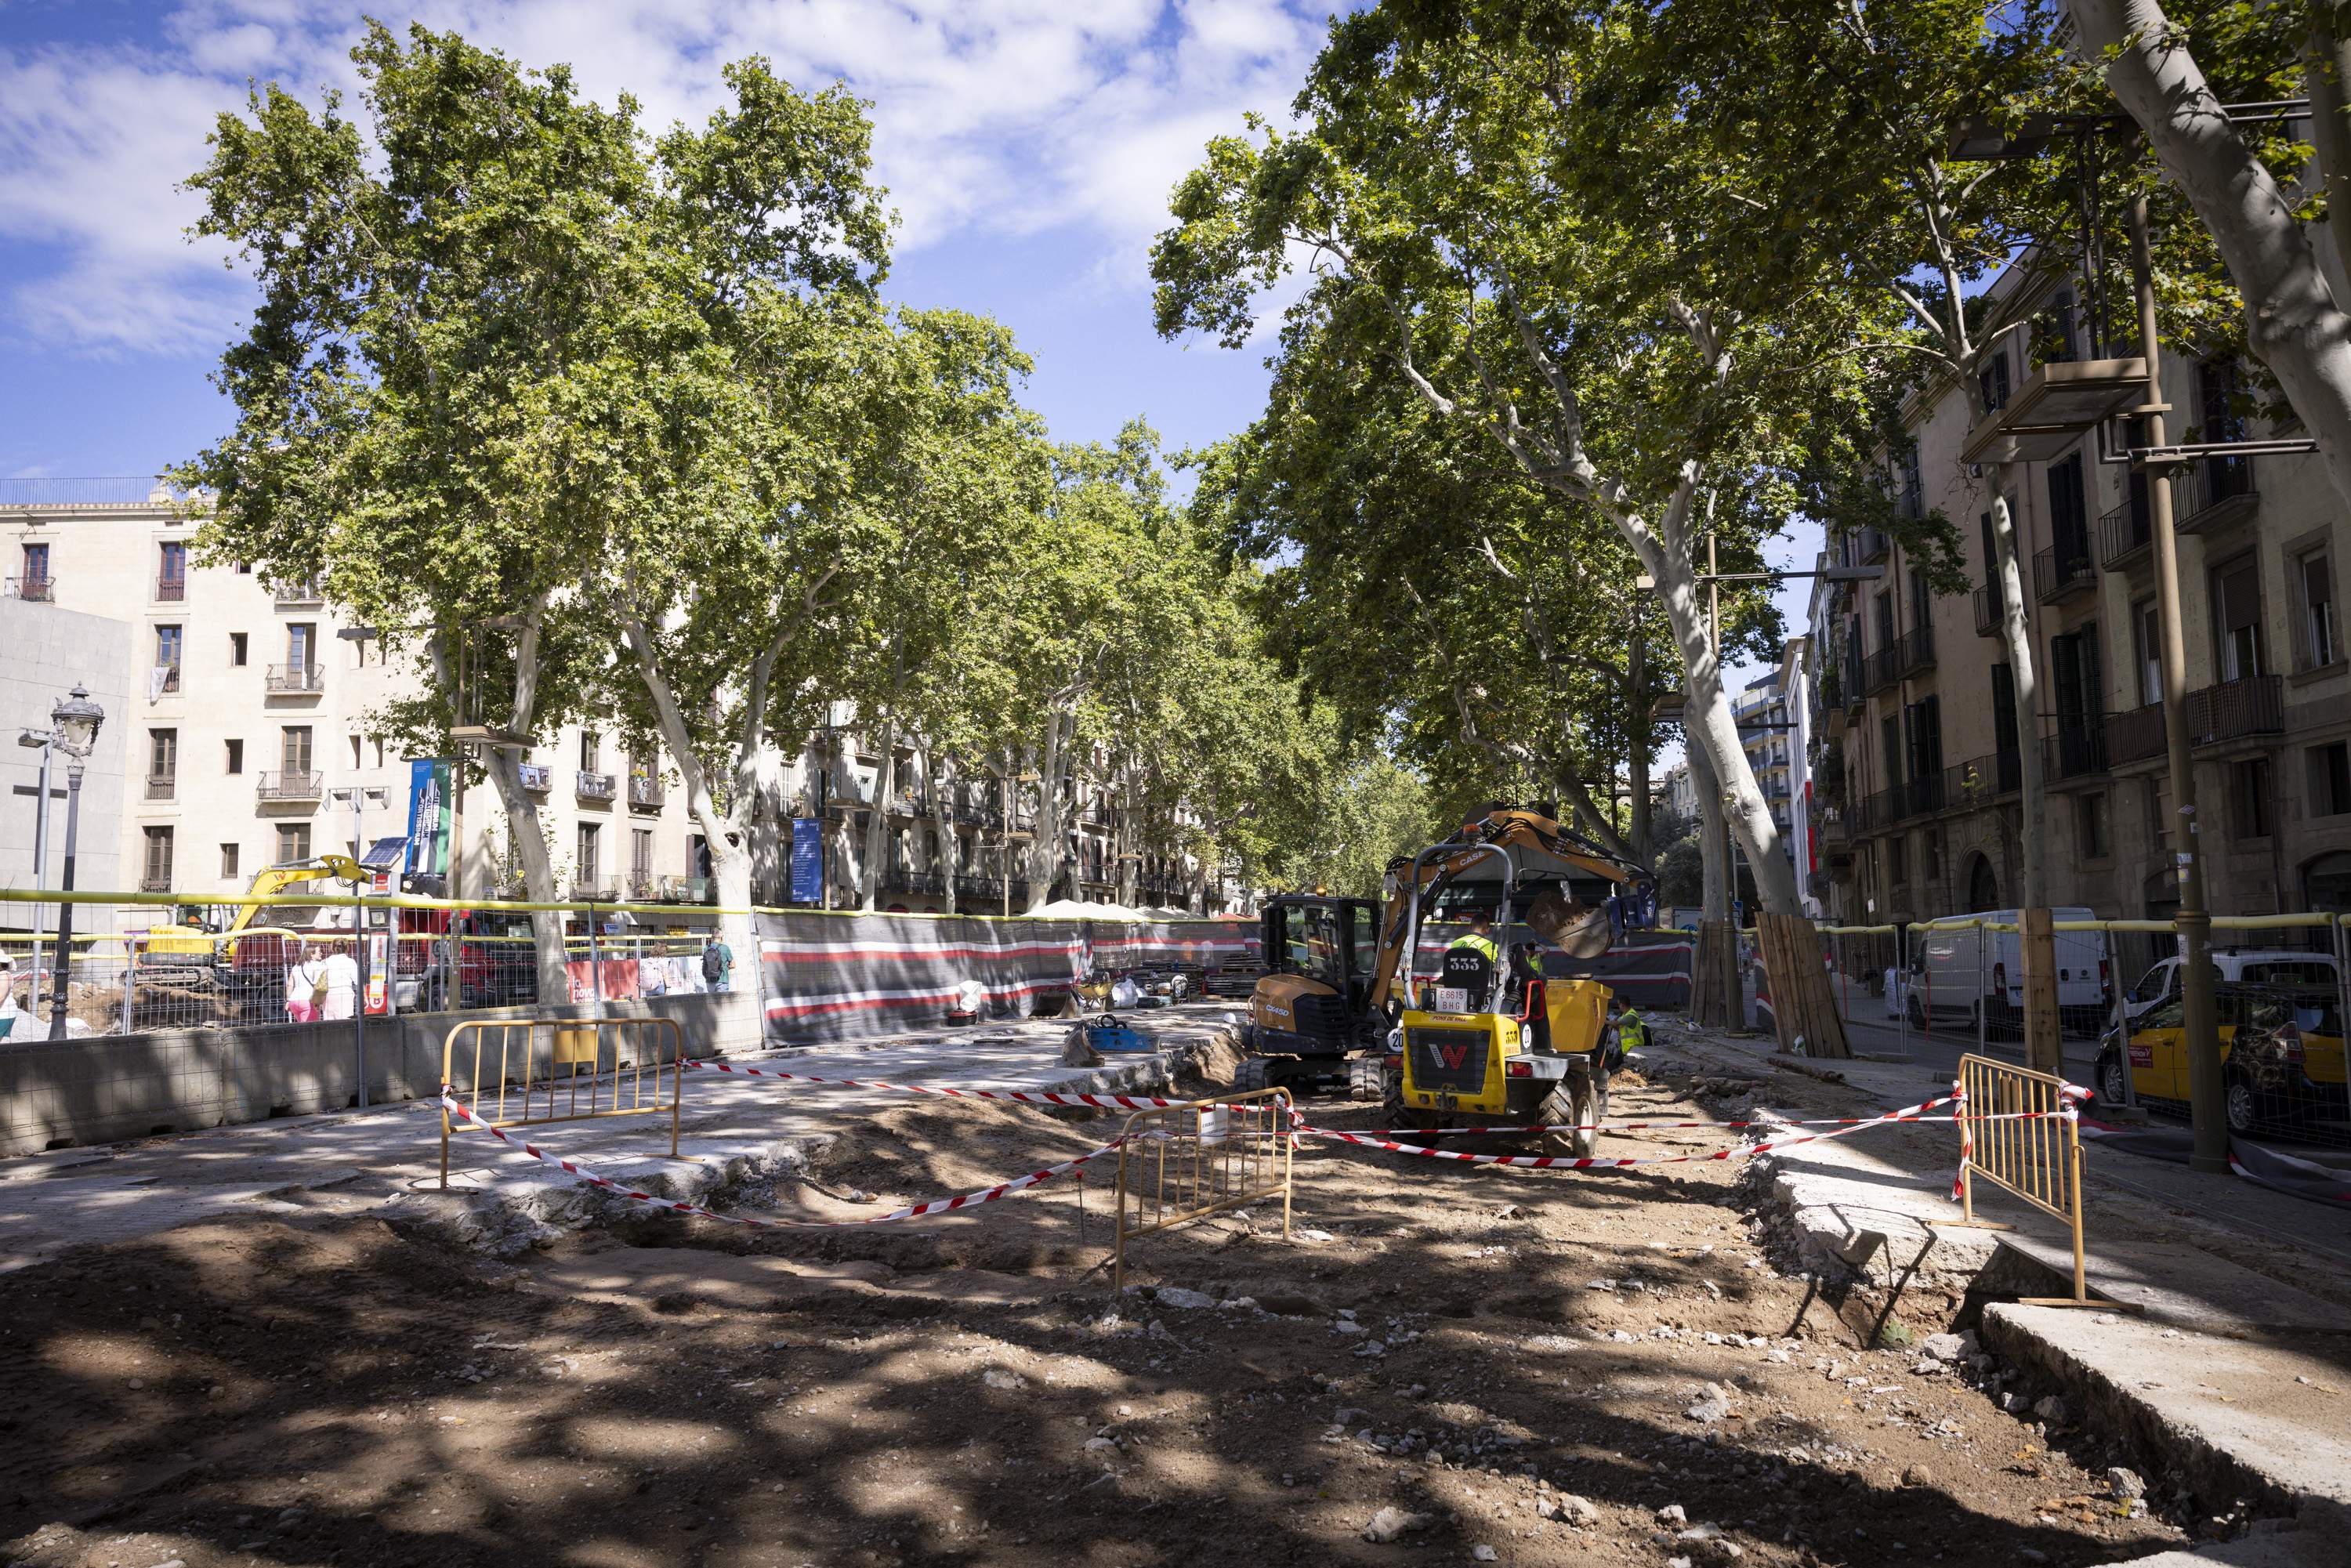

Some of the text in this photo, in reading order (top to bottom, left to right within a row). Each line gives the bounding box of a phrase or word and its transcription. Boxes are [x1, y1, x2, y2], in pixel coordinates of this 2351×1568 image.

[1459, 850, 1485, 866] CASE
[1450, 958, 1480, 971] 333
[1392, 1033, 1404, 1048] 20
